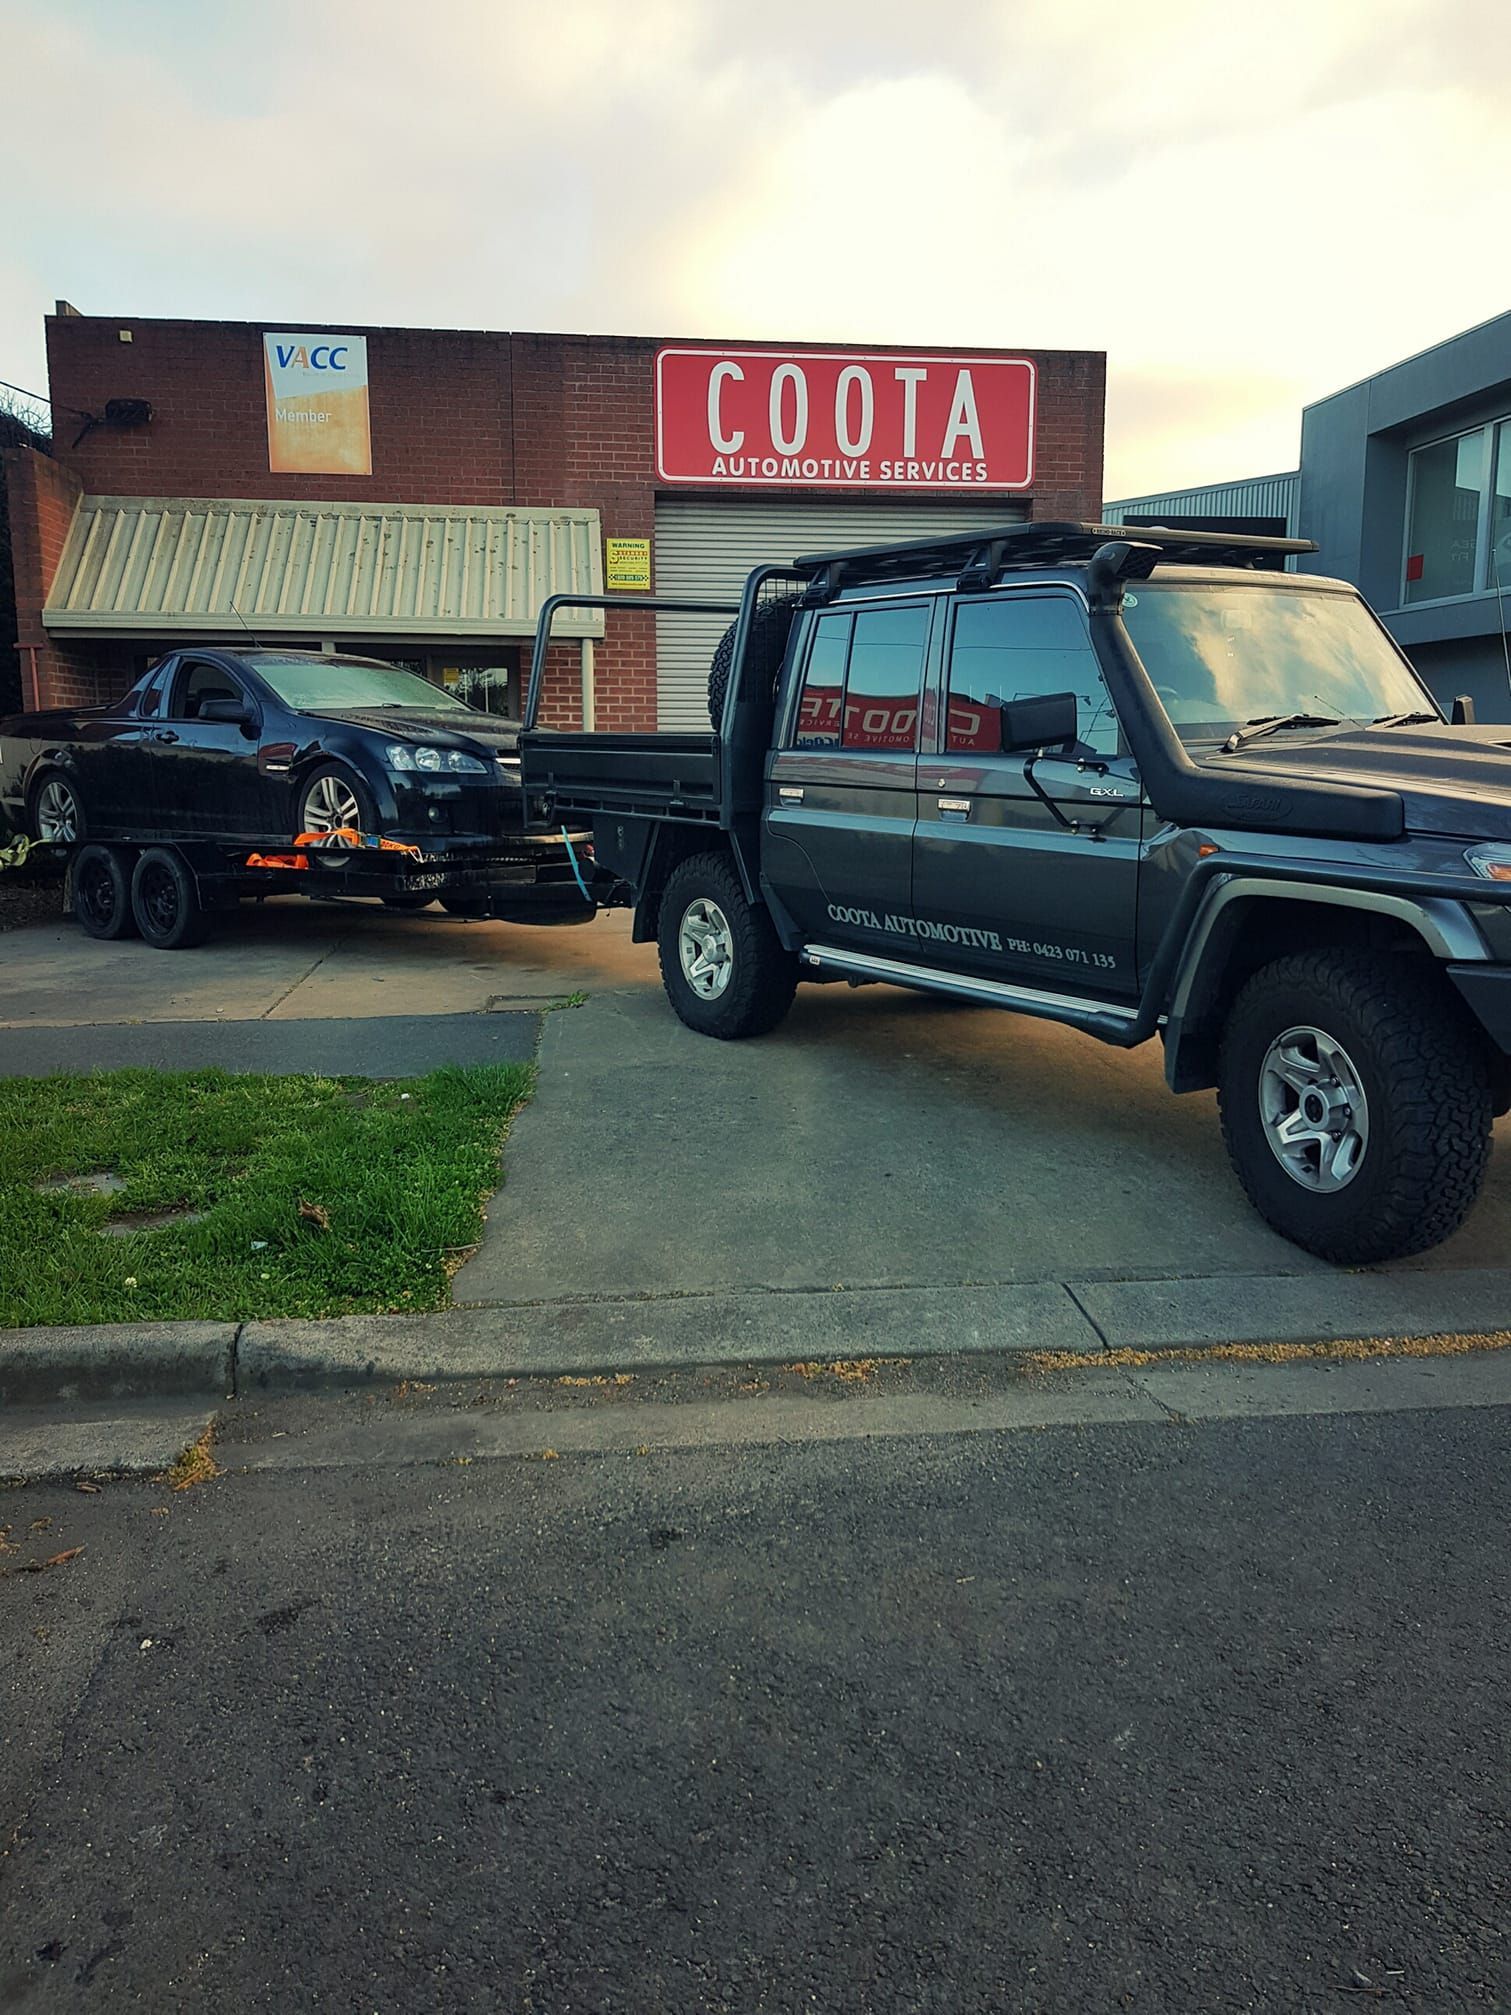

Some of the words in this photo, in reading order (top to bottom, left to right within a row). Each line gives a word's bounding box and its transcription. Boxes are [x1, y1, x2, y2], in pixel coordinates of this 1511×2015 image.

[276, 344, 349, 370] VACC
[275, 407, 333, 423] Member
[707, 360, 985, 459] COOTA
[711, 456, 870, 480] AUTOMOTIVE
[879, 460, 988, 482] SERVICES
[1090, 787, 1124, 797] GXL
[827, 903, 882, 930] COOTA
[884, 913, 1003, 952] AUTOMOTIVE
[1006, 938, 1032, 953] PH:
[1033, 942, 1063, 959] 0423
[1065, 948, 1090, 964] 071
[1092, 953, 1117, 969] 135
